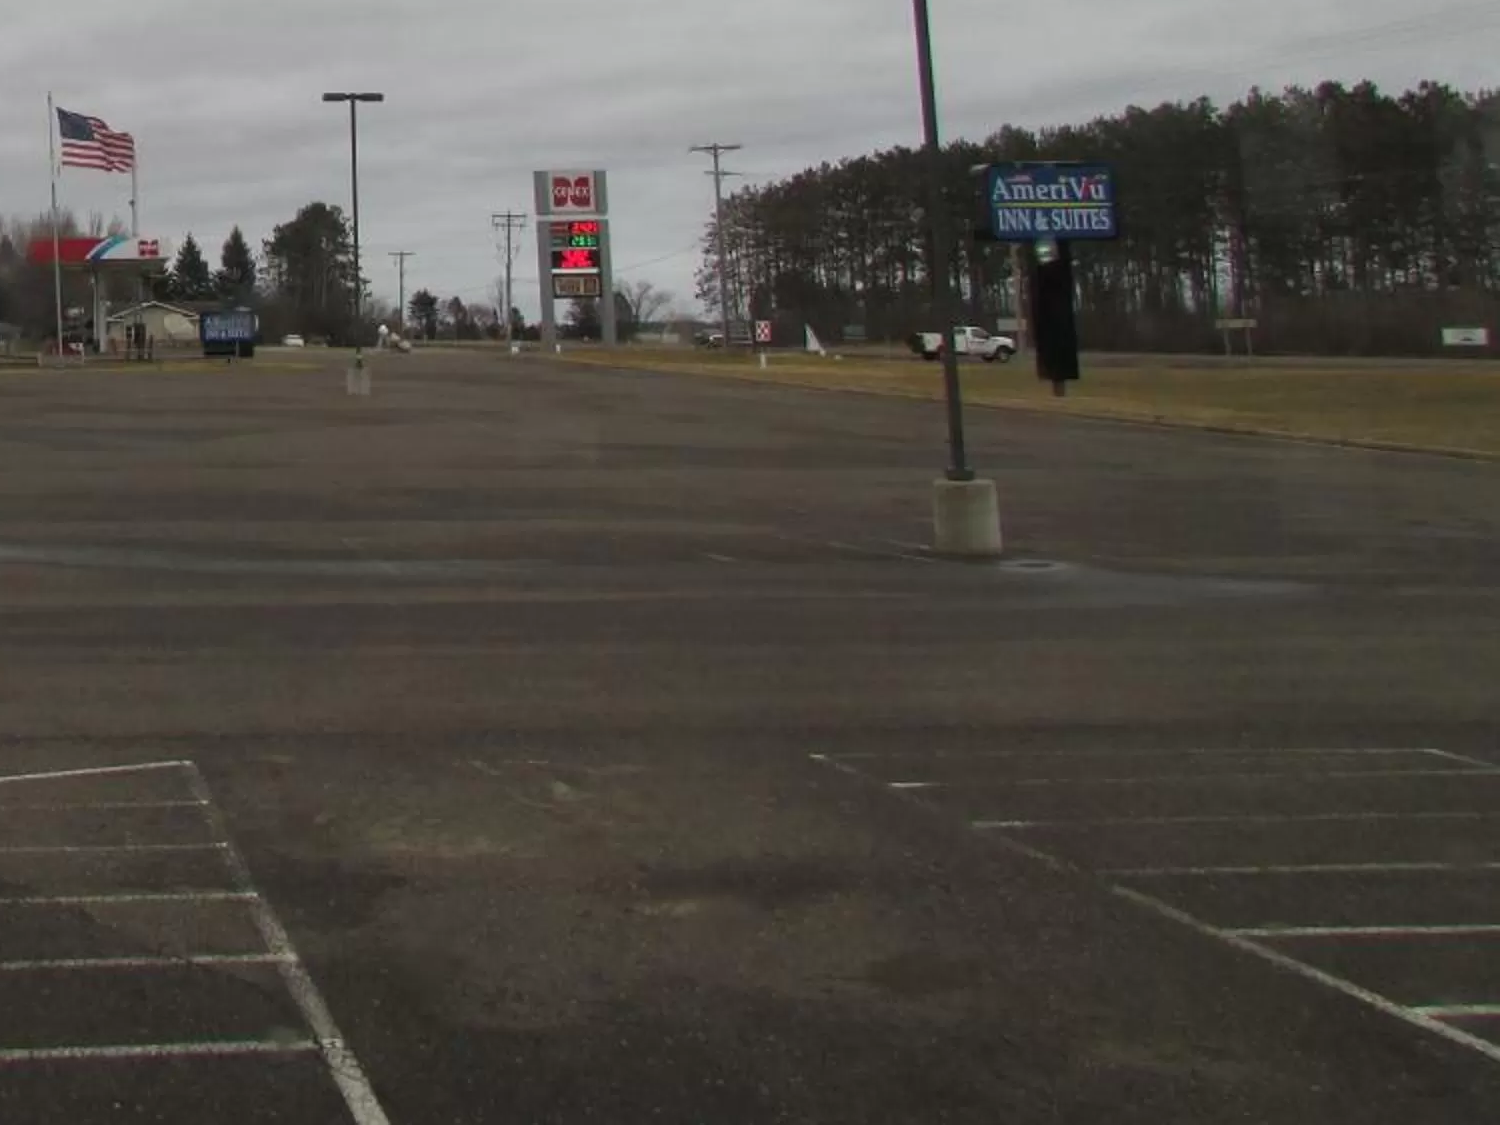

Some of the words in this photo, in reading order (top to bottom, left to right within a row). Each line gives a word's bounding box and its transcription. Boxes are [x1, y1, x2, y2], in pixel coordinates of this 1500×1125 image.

[998, 208, 1032, 231] INN
[1035, 208, 1050, 231] &
[1051, 208, 1111, 230] SUITES
